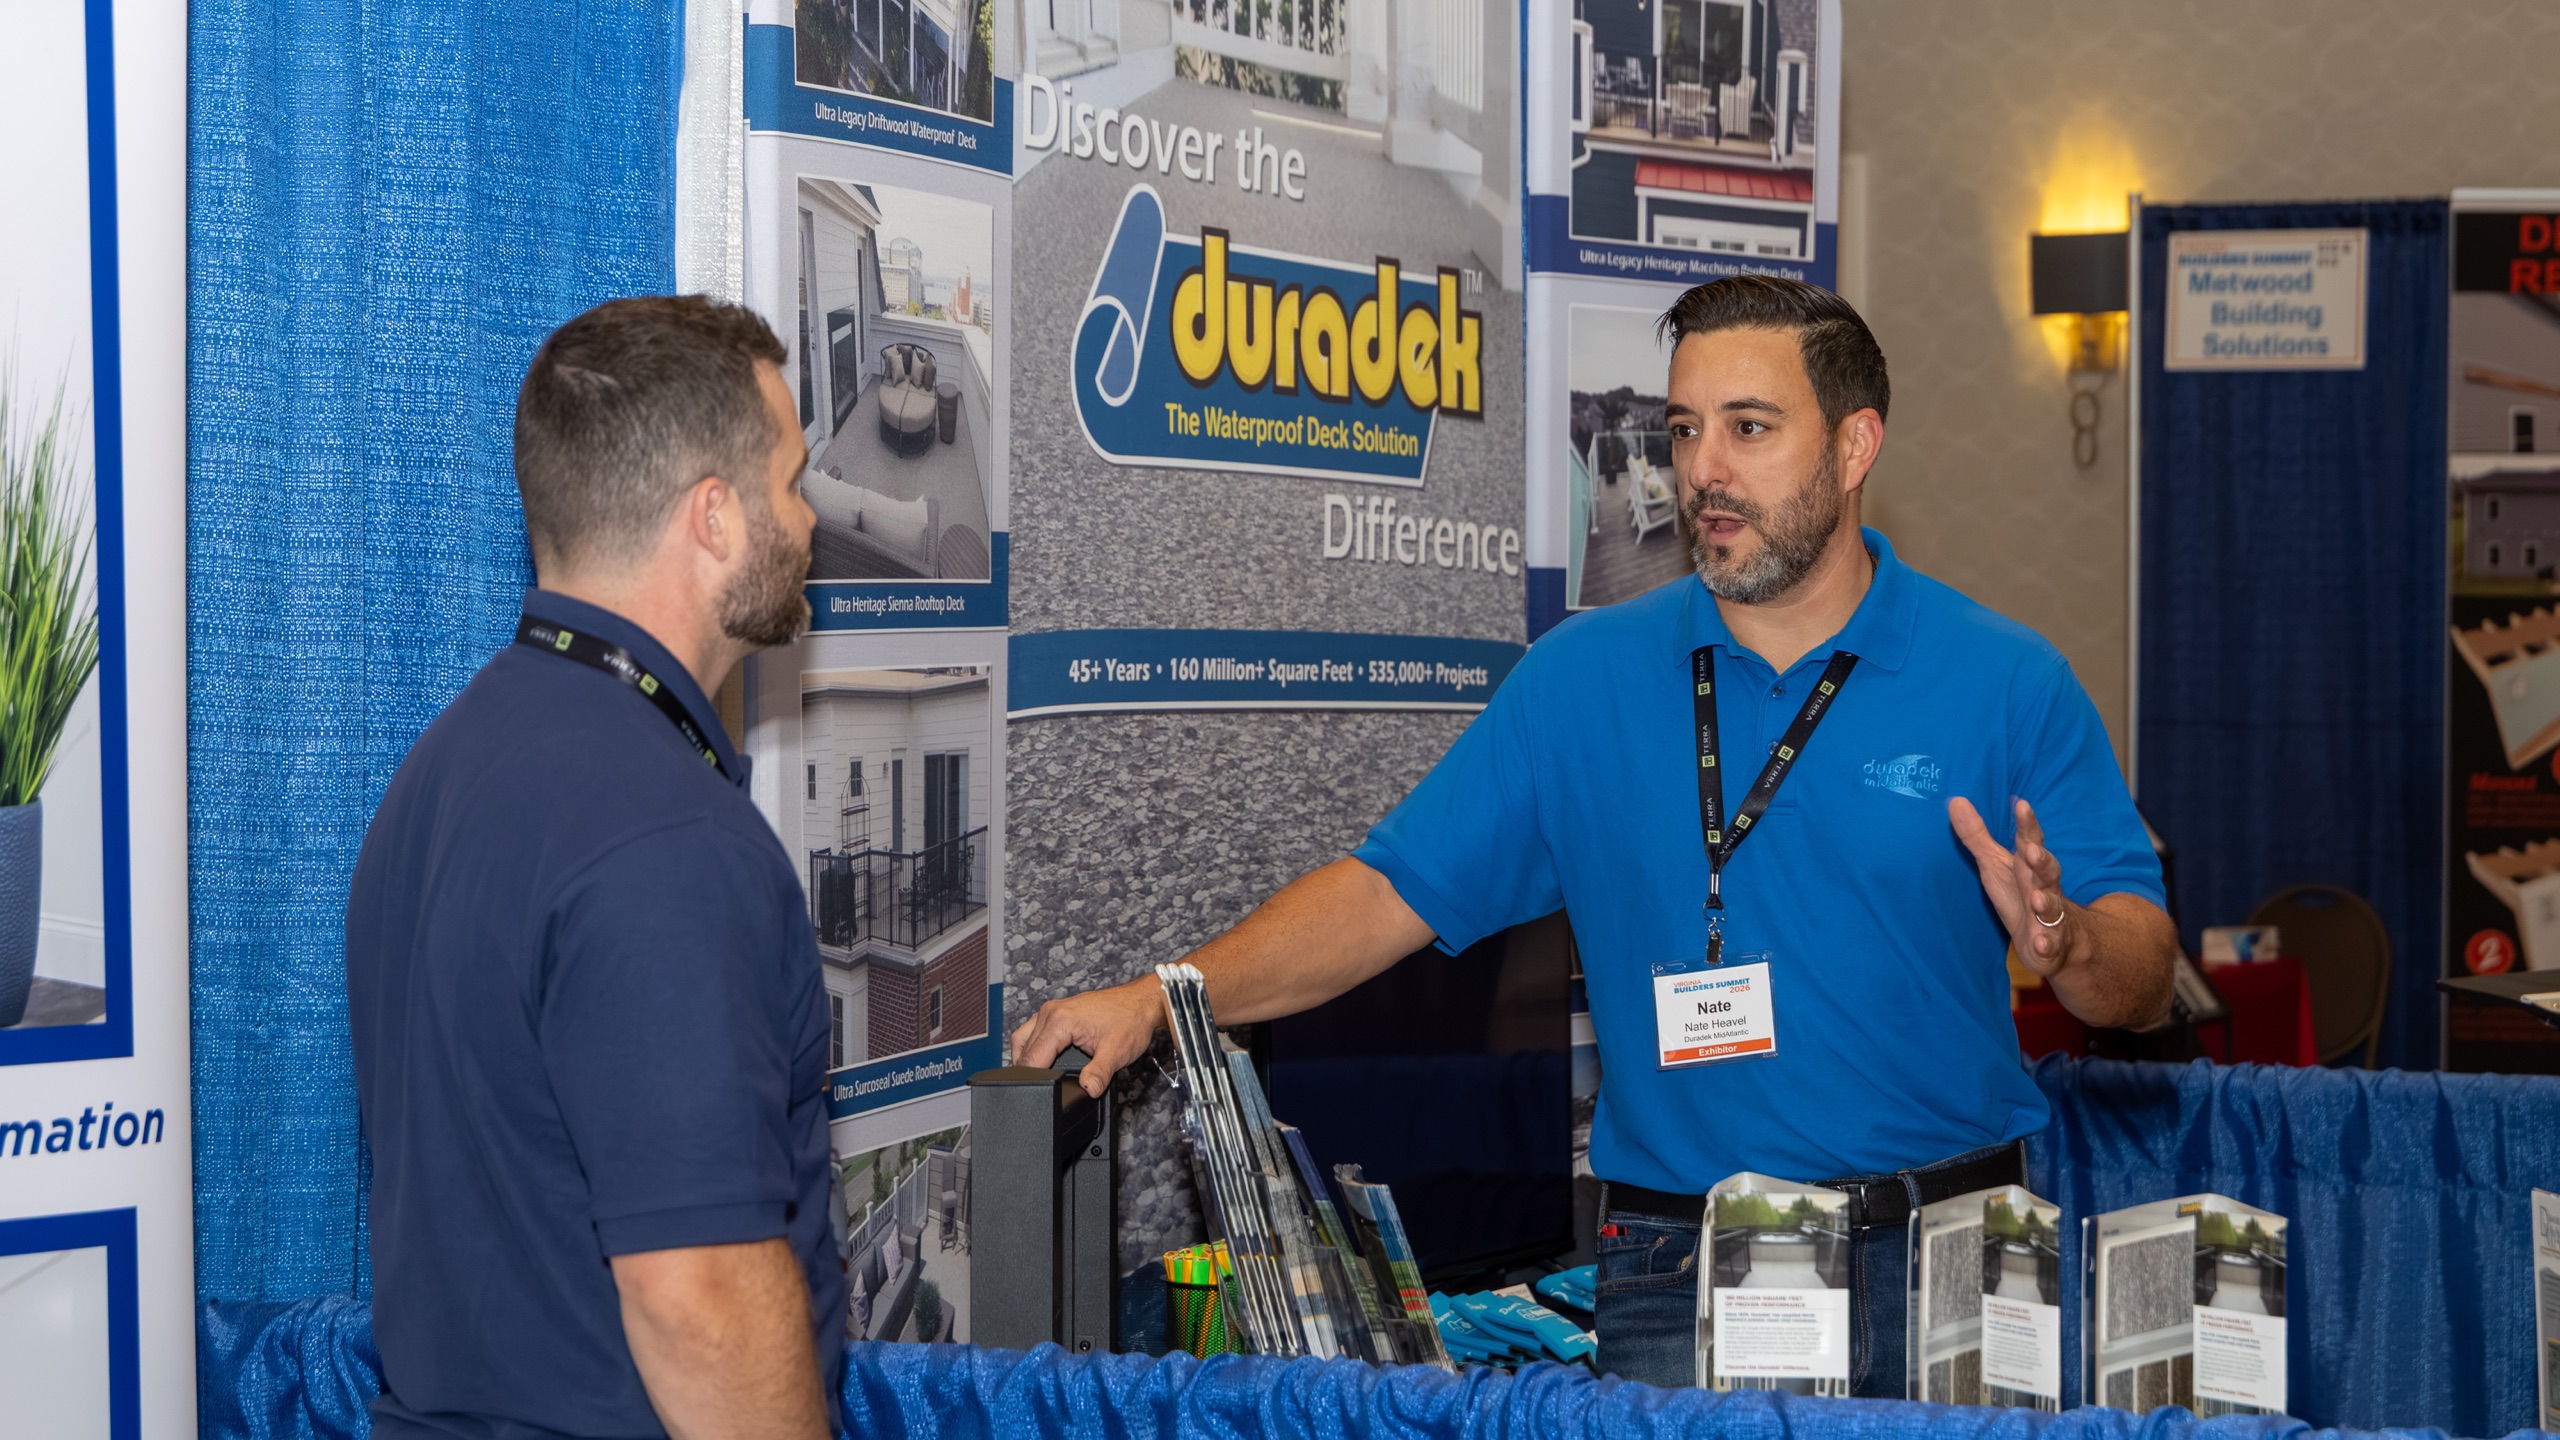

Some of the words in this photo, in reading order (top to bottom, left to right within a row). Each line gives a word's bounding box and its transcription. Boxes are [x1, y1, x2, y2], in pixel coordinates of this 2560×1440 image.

[815, 102, 836, 120] Ultra
[838, 106, 866, 131] Legacy
[868, 112, 909, 135] Driftwood
[910, 121, 955, 146] Waterproof
[957, 131, 977, 150] Deck
[1022, 72, 1224, 182] Discover
[1235, 126, 1307, 200] the
[2519, 213, 2560, 253] D
[1580, 249, 1606, 266] Ultra
[1608, 252, 1643, 272] Legacy
[1644, 256, 1686, 277] Heritage
[1689, 259, 1738, 276] Macchiato
[1463, 269, 1484, 296] TM
[2189, 270, 2313, 294] Metwood
[1170, 226, 1484, 421] duradek
[2211, 302, 2323, 329] Building
[2203, 333, 2329, 356] Solutions
[1165, 402, 1200, 436] The
[1204, 406, 1304, 446] Waterproof
[1307, 416, 1349, 450] Deck
[1352, 421, 1418, 457] Solution
[1323, 493, 1520, 577] Difference
[831, 596, 850, 613] Ultra
[852, 596, 886, 617] Heritage
[888, 595, 914, 612] Sienna
[915, 595, 944, 615] Rooftop
[946, 596, 965, 612] Deck
[1068, 659, 1102, 683] 45+
[1104, 658, 1150, 682] Years
[1170, 657, 1199, 681] 160
[1202, 657, 1265, 681] Million+
[1268, 658, 1319, 688] Square
[1322, 659, 1353, 682] Feet
[1368, 660, 1433, 686] 535,000+
[1436, 662, 1488, 691] Projects
[1806, 694, 1826, 721] TERRA
[1764, 760, 1785, 788] TERRA
[2477, 936, 2502, 971] 2
[1674, 980, 1701, 988] VIRGINIA
[1674, 983, 1714, 994] BUILDERS
[1716, 978, 1750, 989] SUMMIT
[1730, 985, 1750, 993] 2026
[1698, 1000, 1732, 1015] Nate
[1684, 1033, 1712, 1043] Duradek
[1714, 1029, 1749, 1039] MidAtlantic
[1685, 1021, 1708, 1032] Nate
[1712, 1016, 1746, 1029] Heavel
[1698, 1045, 1737, 1056] Exhibitor
[834, 1084, 853, 1101] Ultra
[855, 1073, 890, 1096] Surcoseal
[892, 1069, 914, 1087] Suede
[915, 1061, 944, 1081] Rooftop
[945, 1056, 962, 1074] Deck
[0, 1101, 164, 1157] mation
